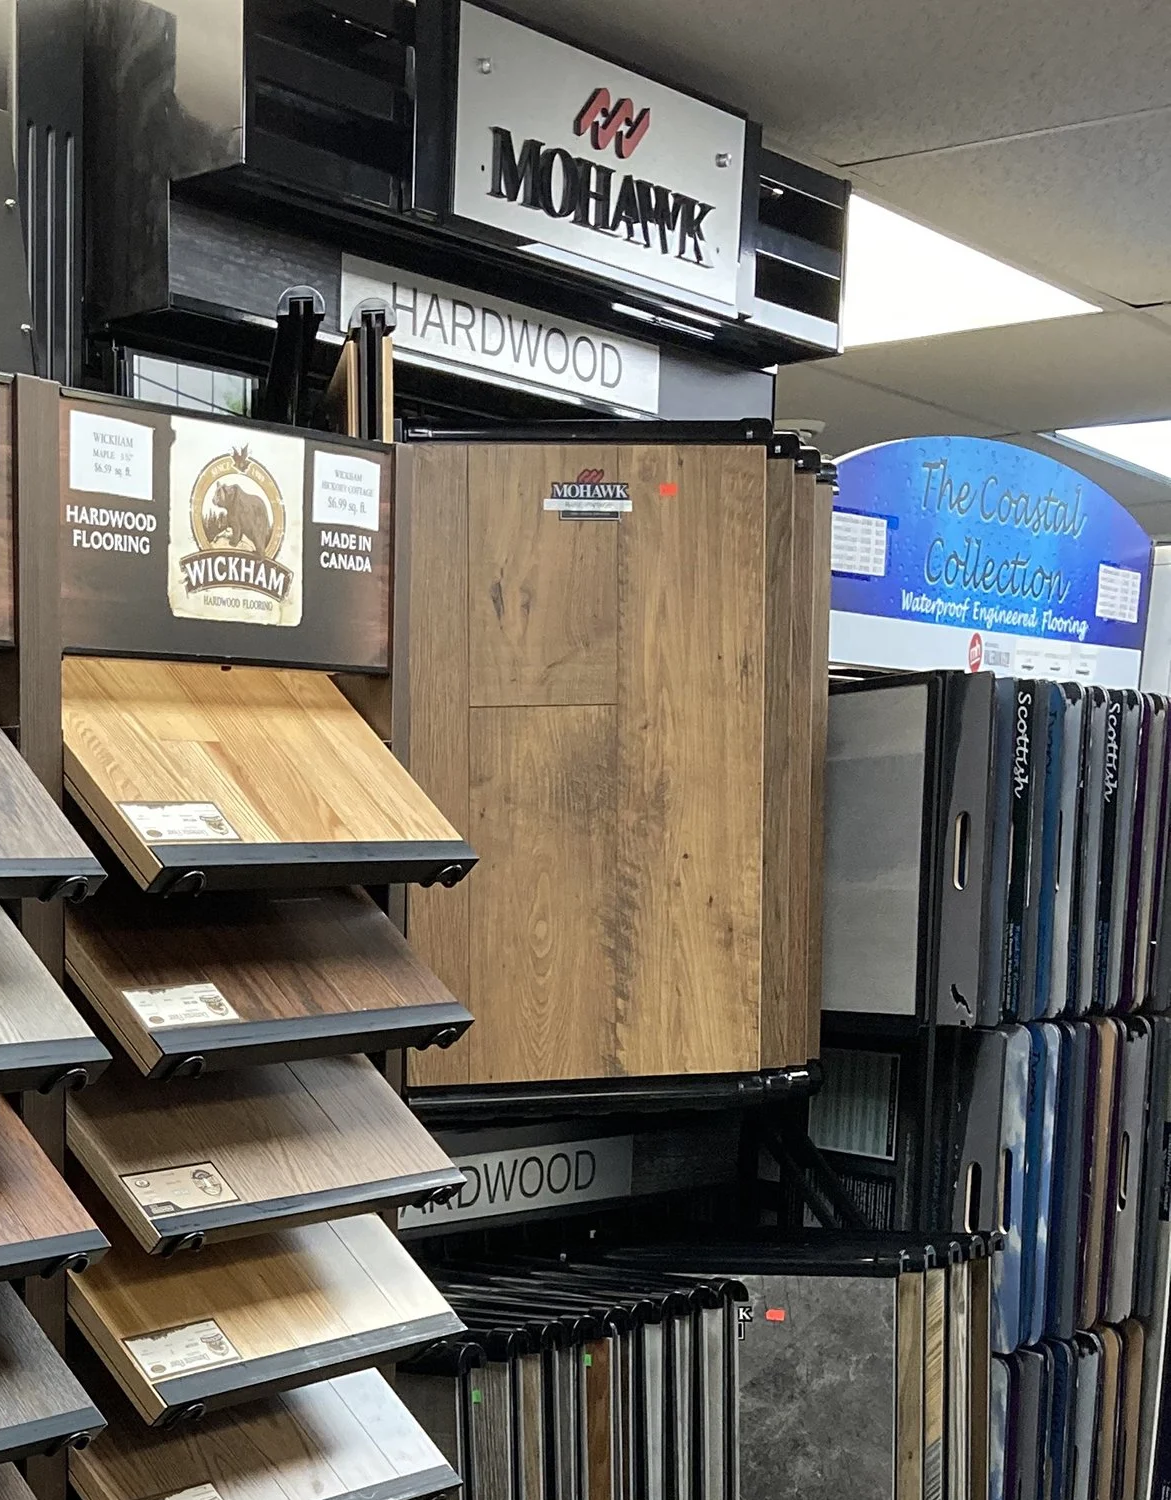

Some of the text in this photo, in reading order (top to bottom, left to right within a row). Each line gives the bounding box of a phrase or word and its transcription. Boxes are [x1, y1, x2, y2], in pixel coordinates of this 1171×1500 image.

[487, 126, 716, 268] MOHAWK
[392, 282, 622, 389] HARDWOOD
[93, 432, 133, 448] WICKHAM
[552, 484, 628, 498] MOHAWK
[921, 460, 1087, 538] The Coastal
[65, 505, 157, 533] HARDWOOD
[72, 529, 150, 555] FLOORING
[320, 551, 372, 573] CANADA
[321, 531, 372, 552] MADE IN
[185, 556, 285, 592] WICKHAM
[924, 536, 1070, 601] Collection
[901, 590, 1088, 640] Waterproof Engineered Flooring
[1014, 691, 1031, 799] Scottish
[1104, 702, 1120, 802] Scottish
